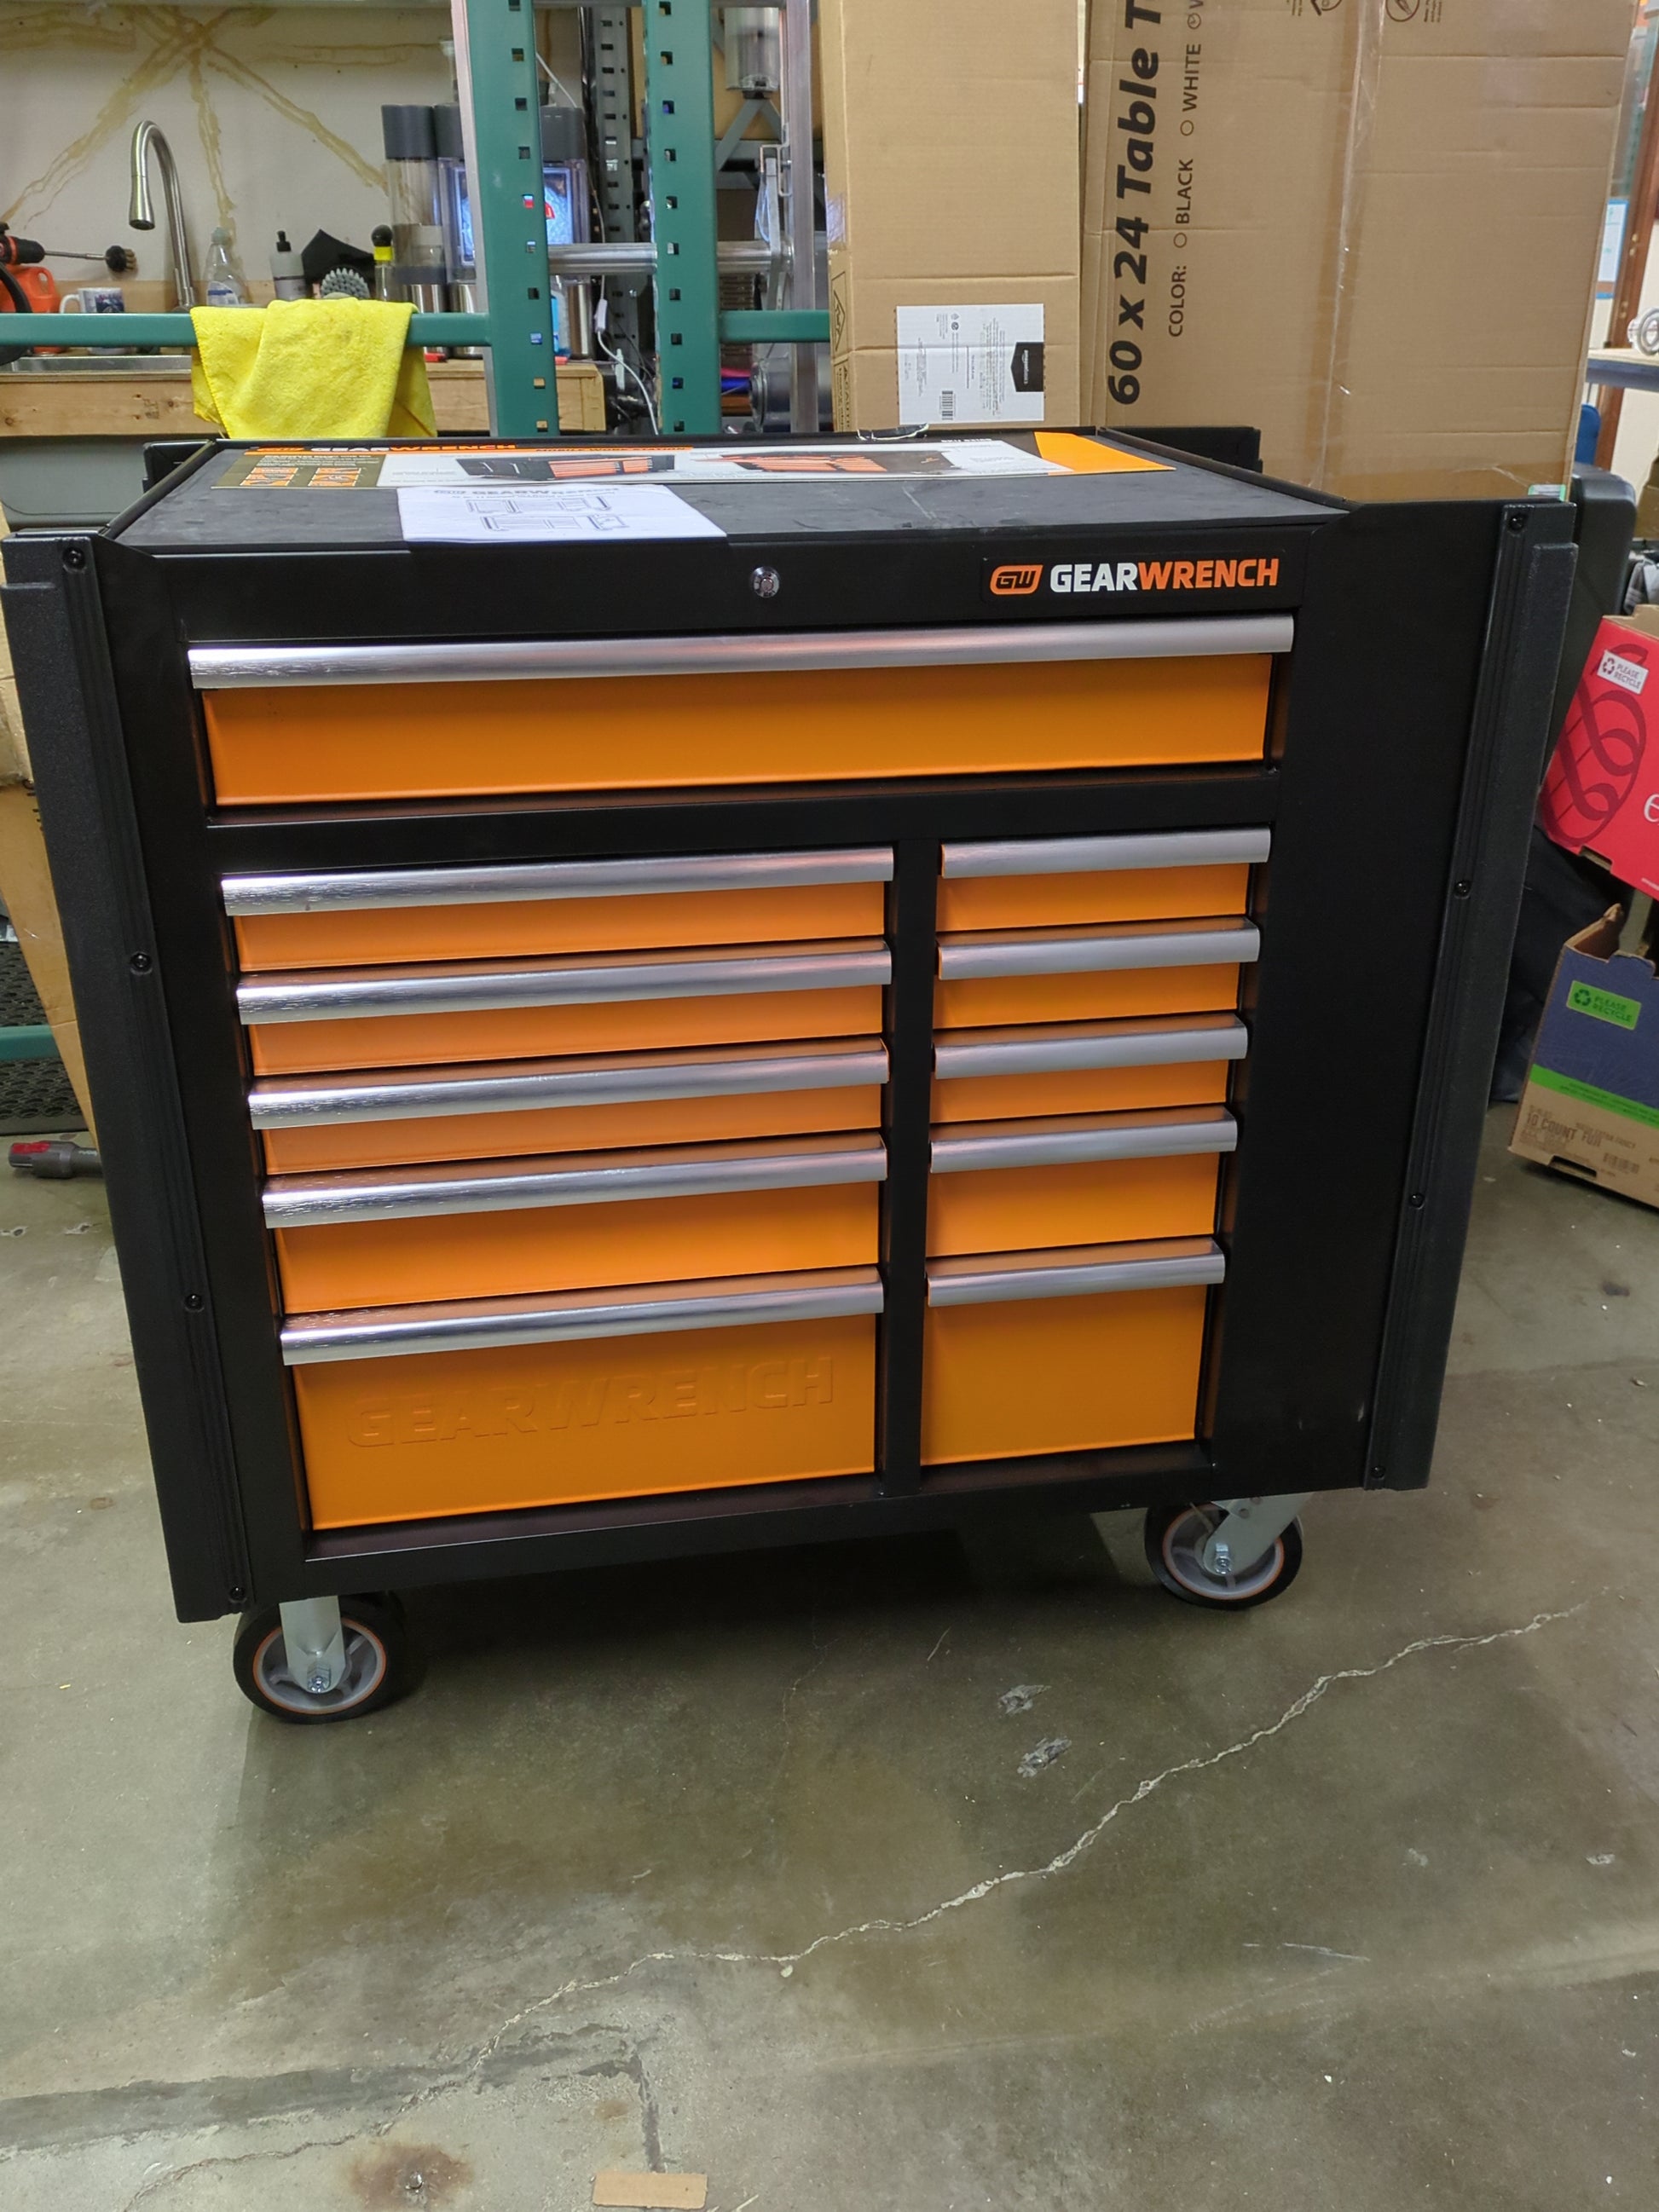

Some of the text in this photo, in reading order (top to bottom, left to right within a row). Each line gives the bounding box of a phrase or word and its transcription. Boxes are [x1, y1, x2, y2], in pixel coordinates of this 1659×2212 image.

[1116, 48, 1159, 199] Table
[1168, 43, 1201, 337] COLOR: BLACK WHITE
[1113, 217, 1149, 285] 24
[1119, 294, 1145, 331] x
[1108, 340, 1142, 405] 60
[1049, 558, 1279, 592] GEARWRENCH
[1614, 672, 1642, 689] RECYCLE
[1616, 664, 1639, 679] PLEASE
[1541, 1118, 1577, 1141] COUNT
[346, 1356, 834, 1448] GEARWRENCH
